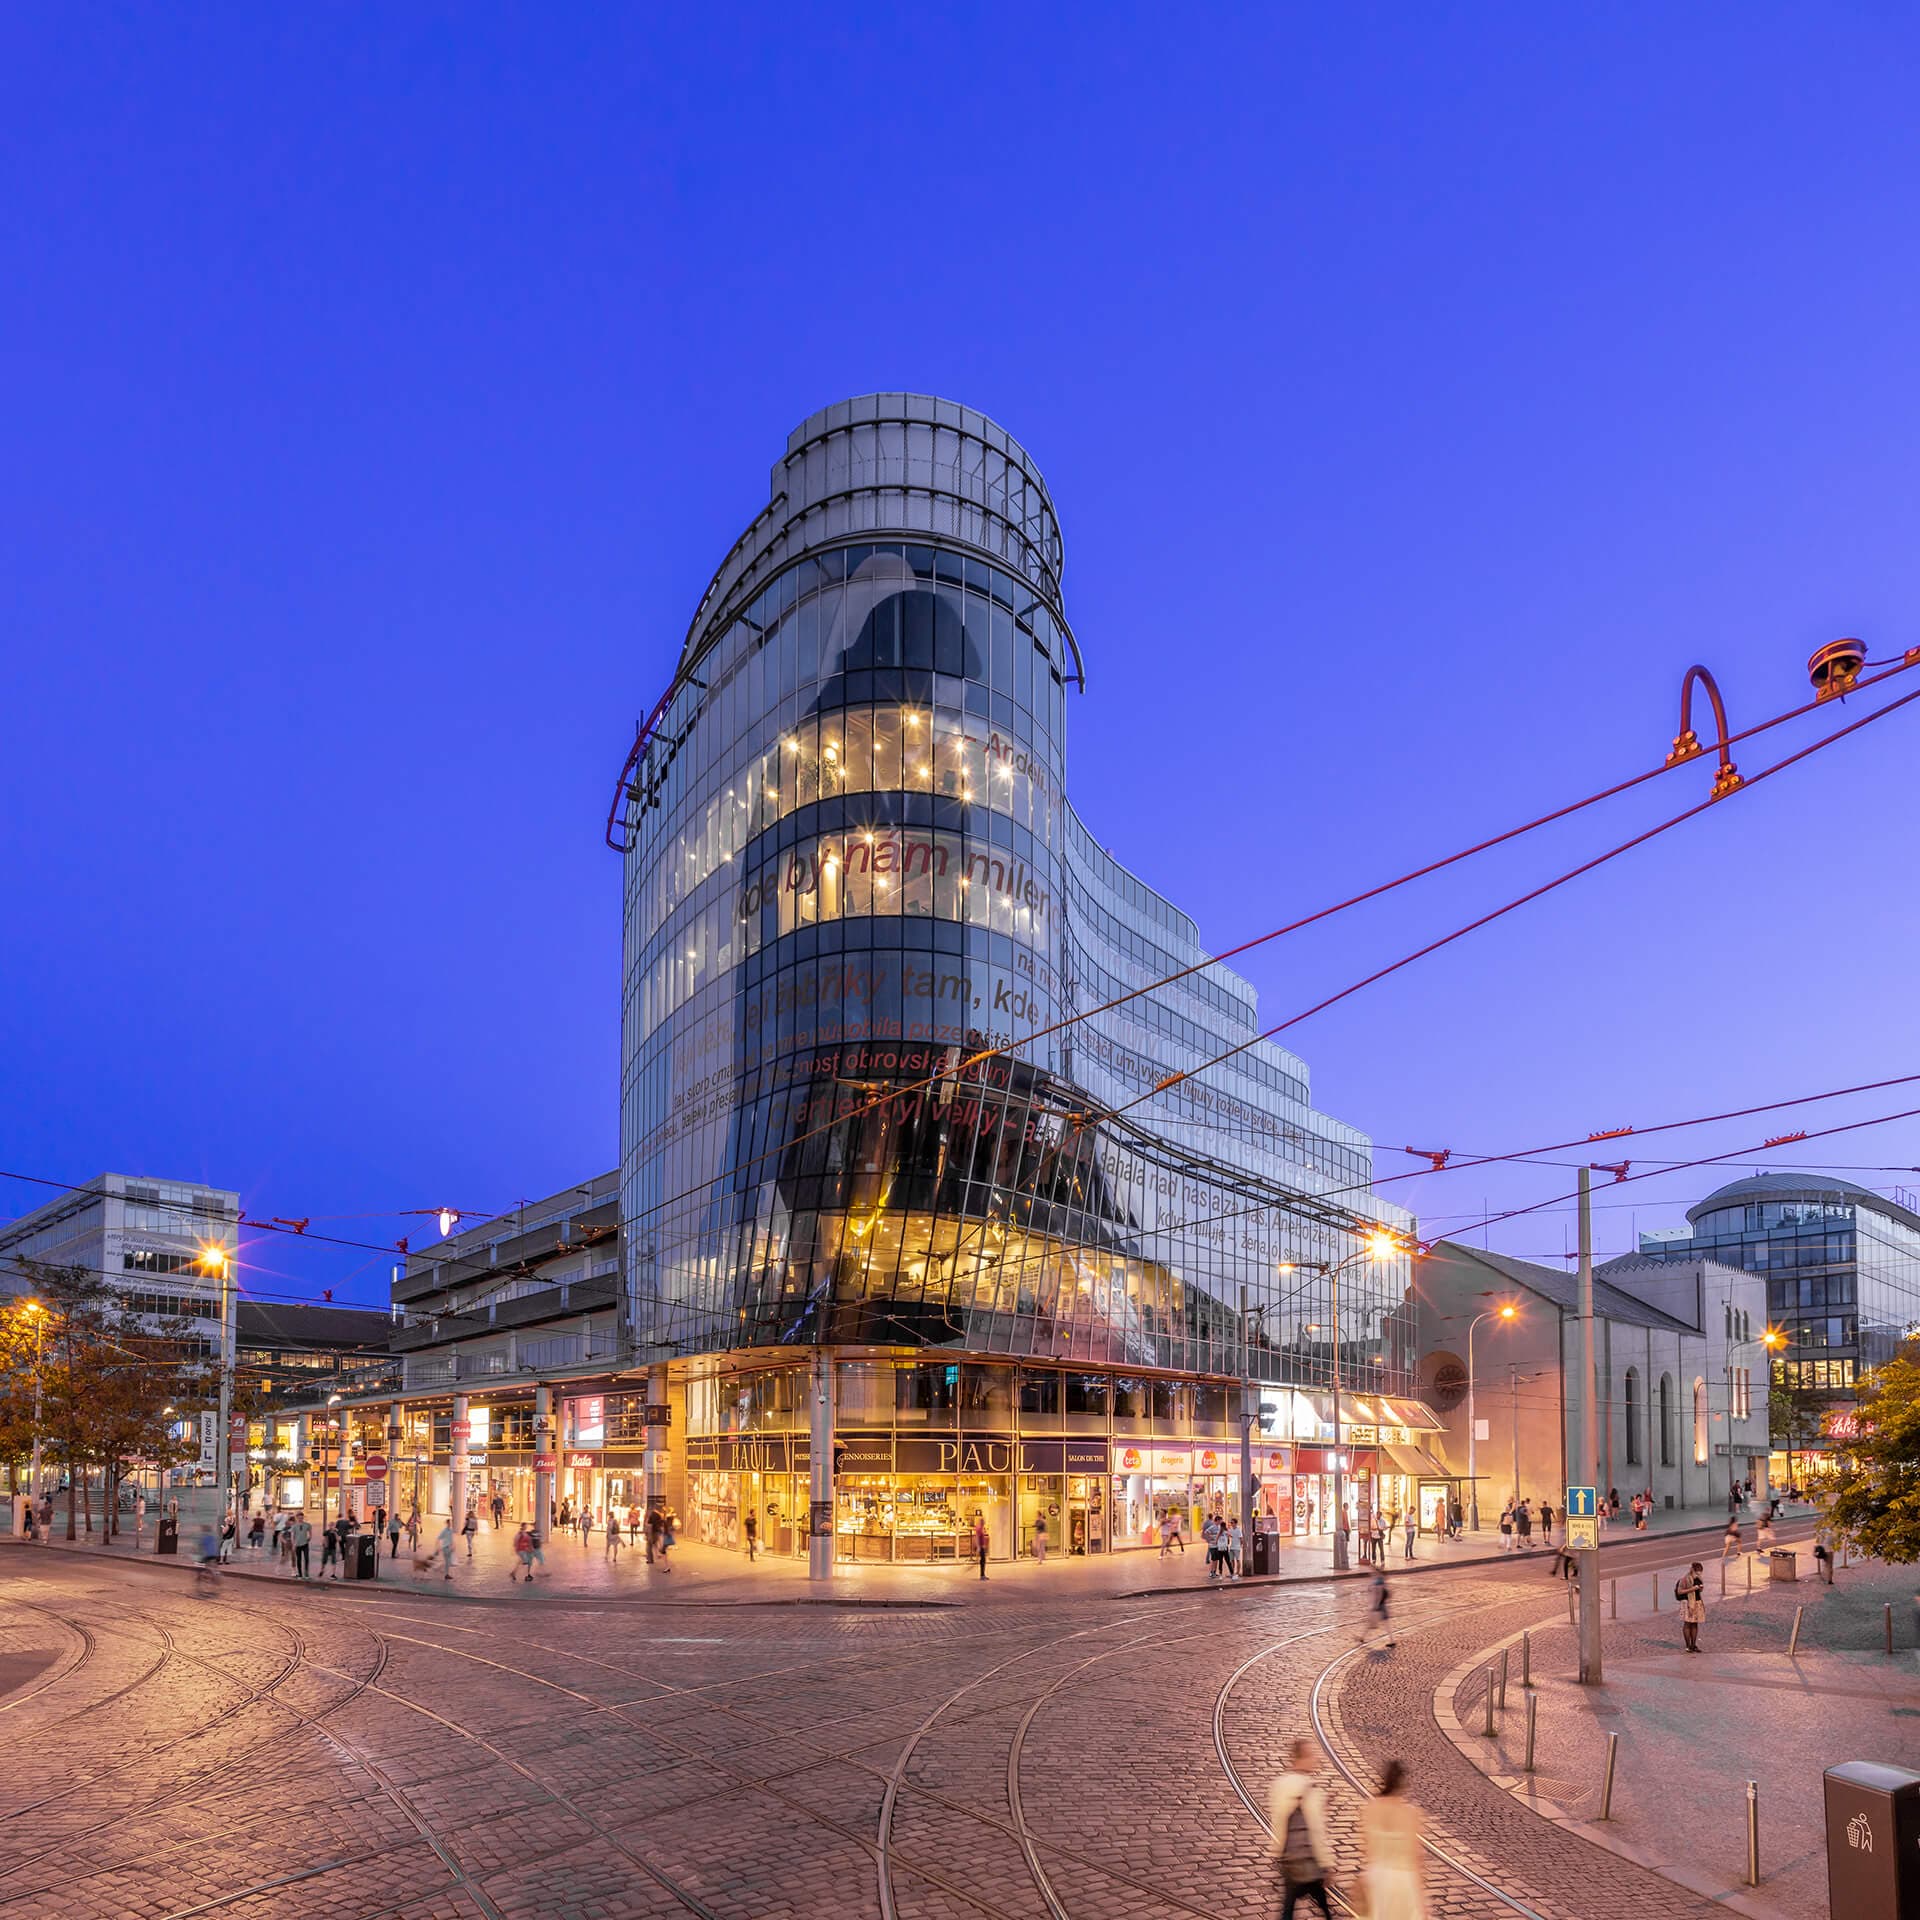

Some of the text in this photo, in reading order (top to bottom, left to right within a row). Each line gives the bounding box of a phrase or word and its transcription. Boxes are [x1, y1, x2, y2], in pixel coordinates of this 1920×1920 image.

[785, 846, 831, 896] by
[844, 829, 949, 877] nám
[903, 963, 981, 1010] tam,
[993, 979, 1039, 1026] kde
[731, 1443, 776, 1471] PAUL
[843, 1452, 892, 1461] ENNOISERIES
[935, 1442, 1035, 1472] PAUL
[1125, 1456, 1141, 1465] teta
[1160, 1455, 1184, 1466] drogerie
[1203, 1457, 1218, 1466] teta
[1270, 1458, 1284, 1467] teta
